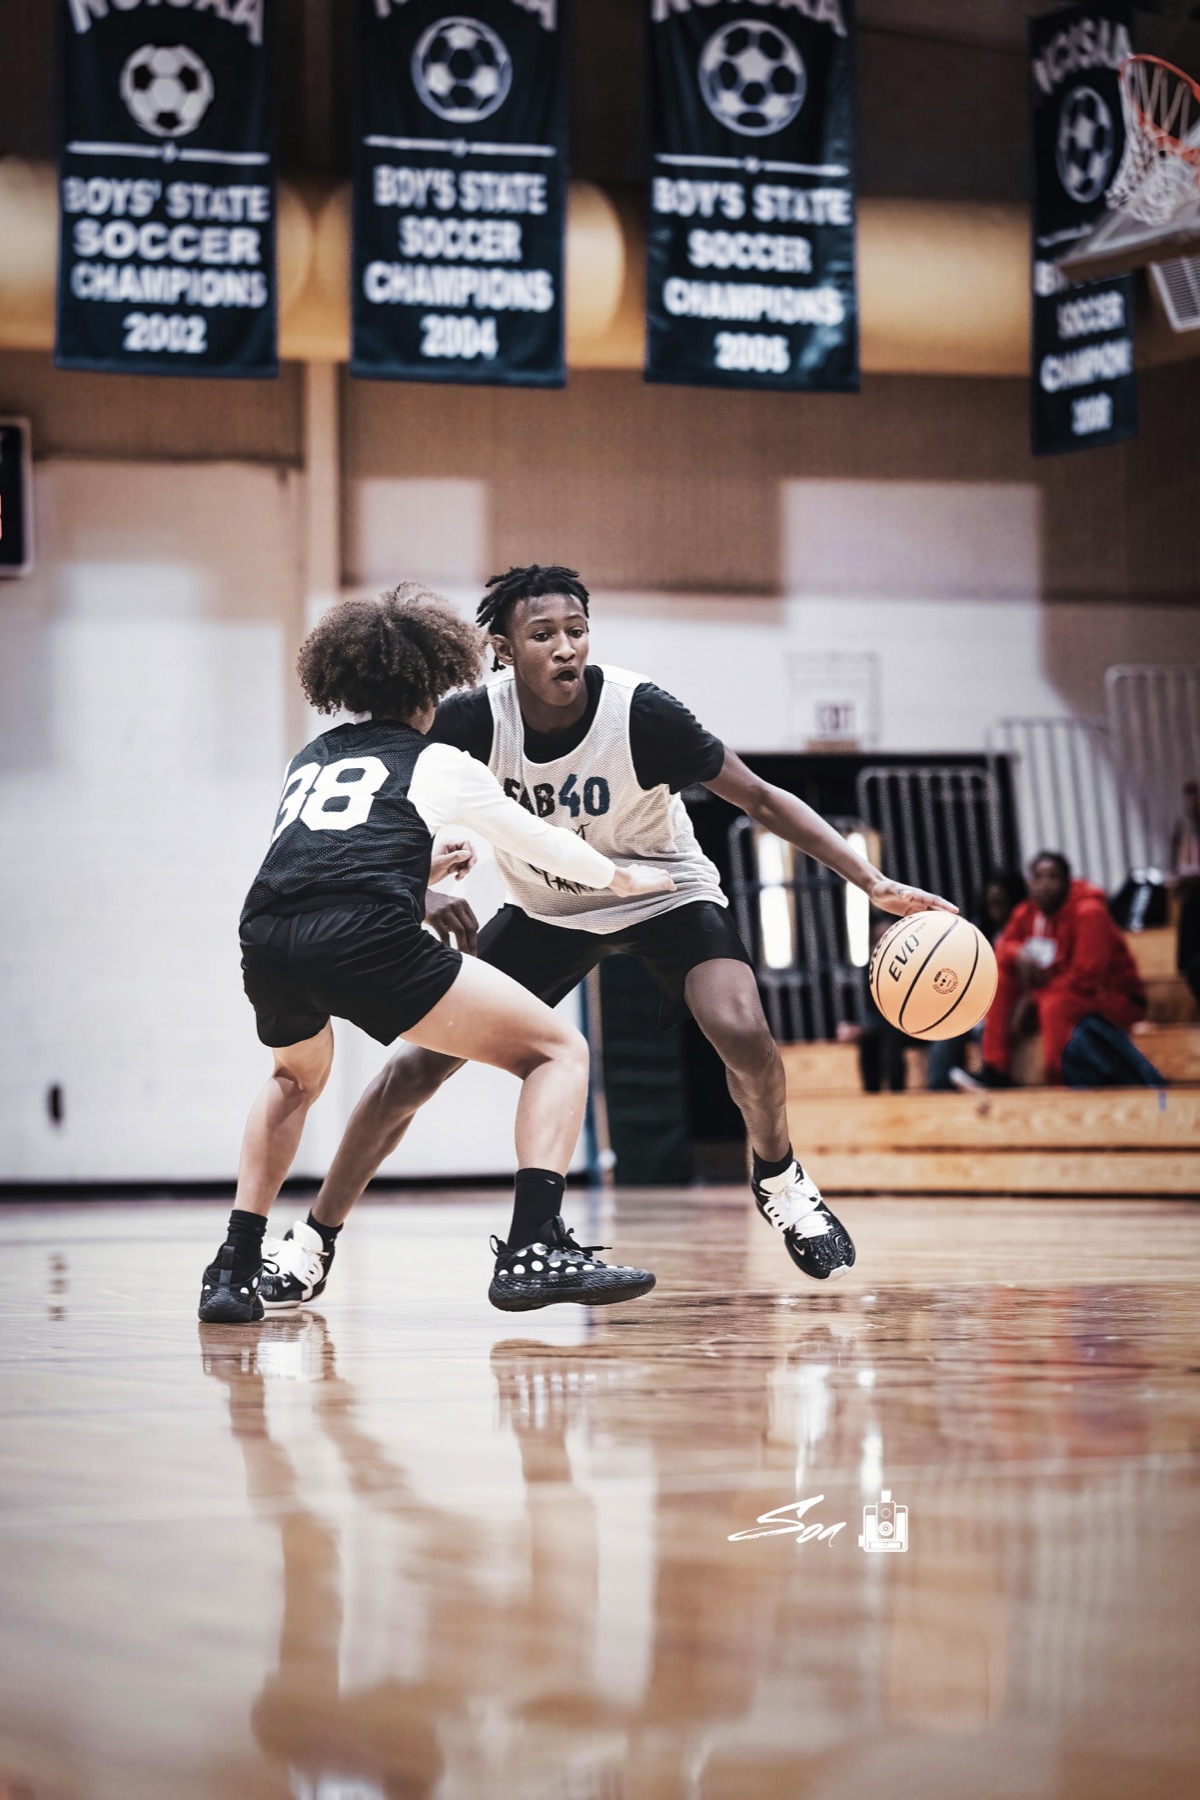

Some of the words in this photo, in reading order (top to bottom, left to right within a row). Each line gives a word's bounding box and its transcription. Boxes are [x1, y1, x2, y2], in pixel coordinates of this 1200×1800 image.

[167, 183, 269, 220] STATE
[376, 166, 455, 210] BOY'S
[461, 173, 546, 214] STATE
[655, 178, 744, 218] BOY'S
[754, 186, 851, 225] STATE
[75, 219, 259, 263] SOCCER
[402, 217, 520, 261] SOCCER
[690, 230, 811, 273] SOCCER
[72, 264, 266, 307] CHAMPIONS
[365, 262, 553, 311] CHAMPIONS
[664, 278, 844, 325] CHAMPIONS
[124, 314, 206, 352] 2002
[420, 314, 497, 359] 2004
[271, 756, 390, 844] 38
[888, 933, 920, 983] EVO
